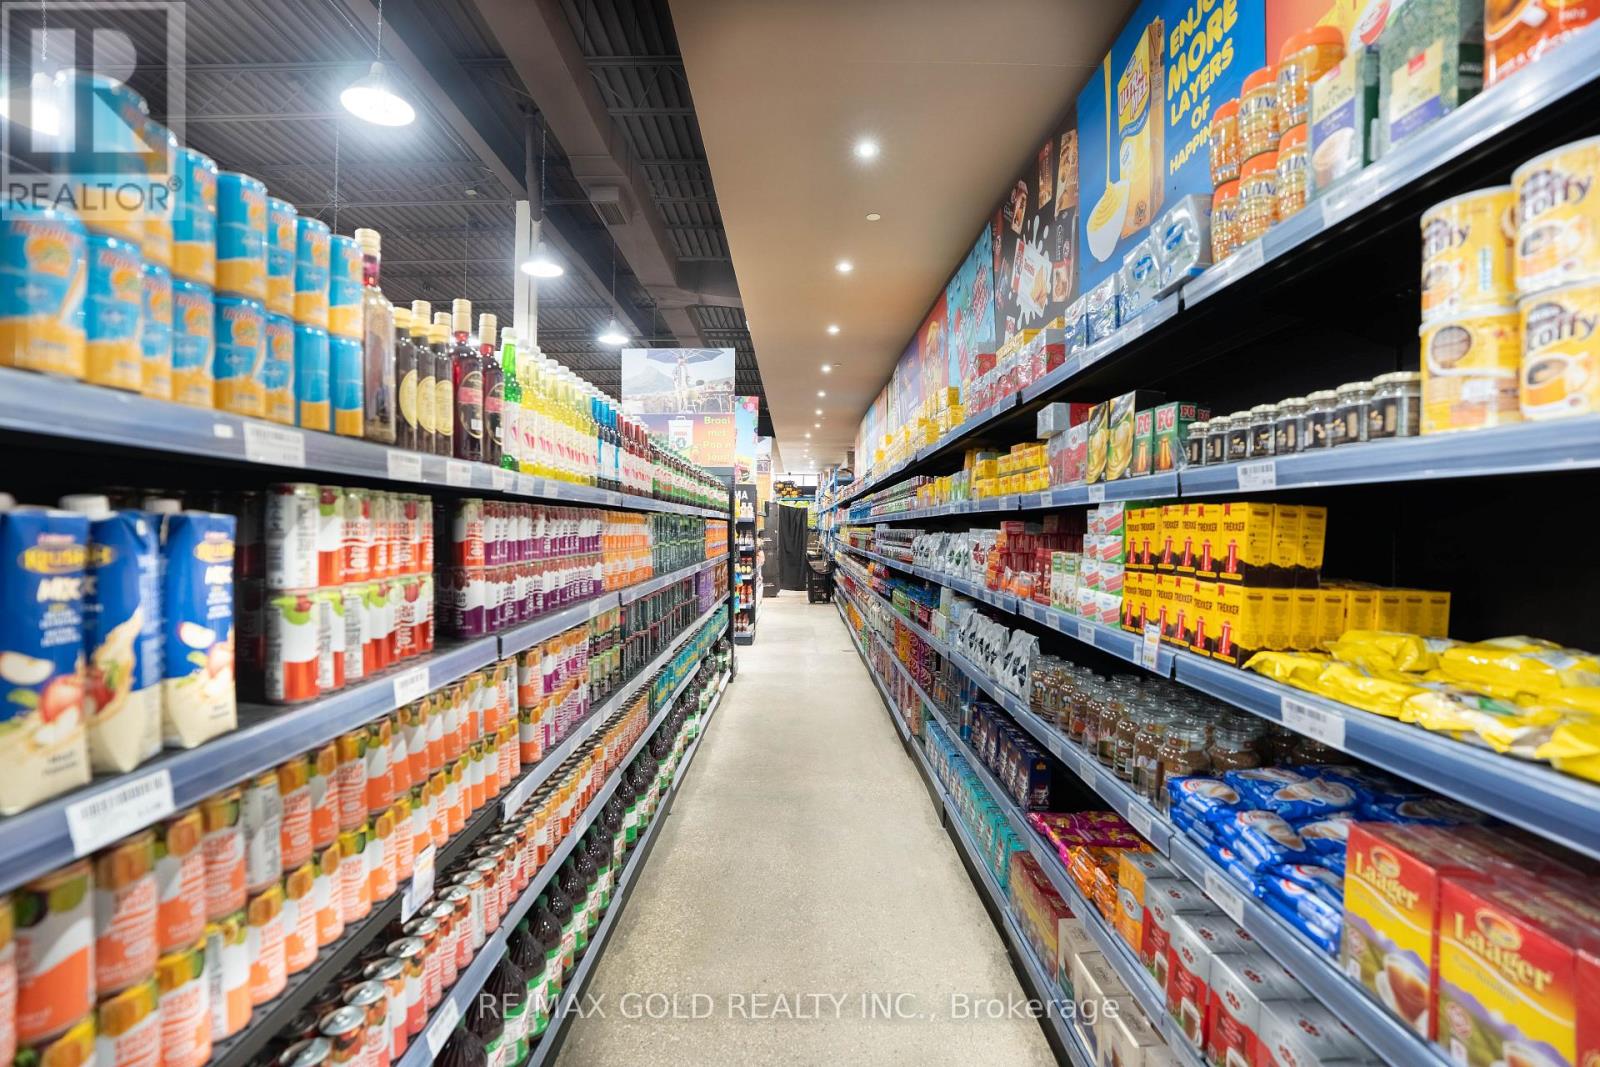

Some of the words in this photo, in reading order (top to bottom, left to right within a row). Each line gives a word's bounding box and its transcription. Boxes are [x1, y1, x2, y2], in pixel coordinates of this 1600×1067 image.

[1170, 0, 1215, 58] ENJO
[1168, 0, 1238, 101] MORE
[1171, 37, 1234, 127] LAYERS
[1191, 94, 1210, 129] OF
[1170, 119, 1212, 176] HAPPIN
[1157, 405, 1176, 433] FG
[1181, 404, 1196, 418] FG
[1136, 412, 1152, 437] FG
[1197, 522, 1217, 532] TREKKER
[1223, 521, 1245, 532] TREKKER
[1156, 589, 1173, 600] TREKKER
[1174, 592, 1193, 604] TREKKER
[1194, 598, 1212, 611] TREKKER
[1217, 601, 1239, 615] TREKKER
[1354, 851, 1419, 910] Laager
[1453, 912, 1553, 992] Laager
